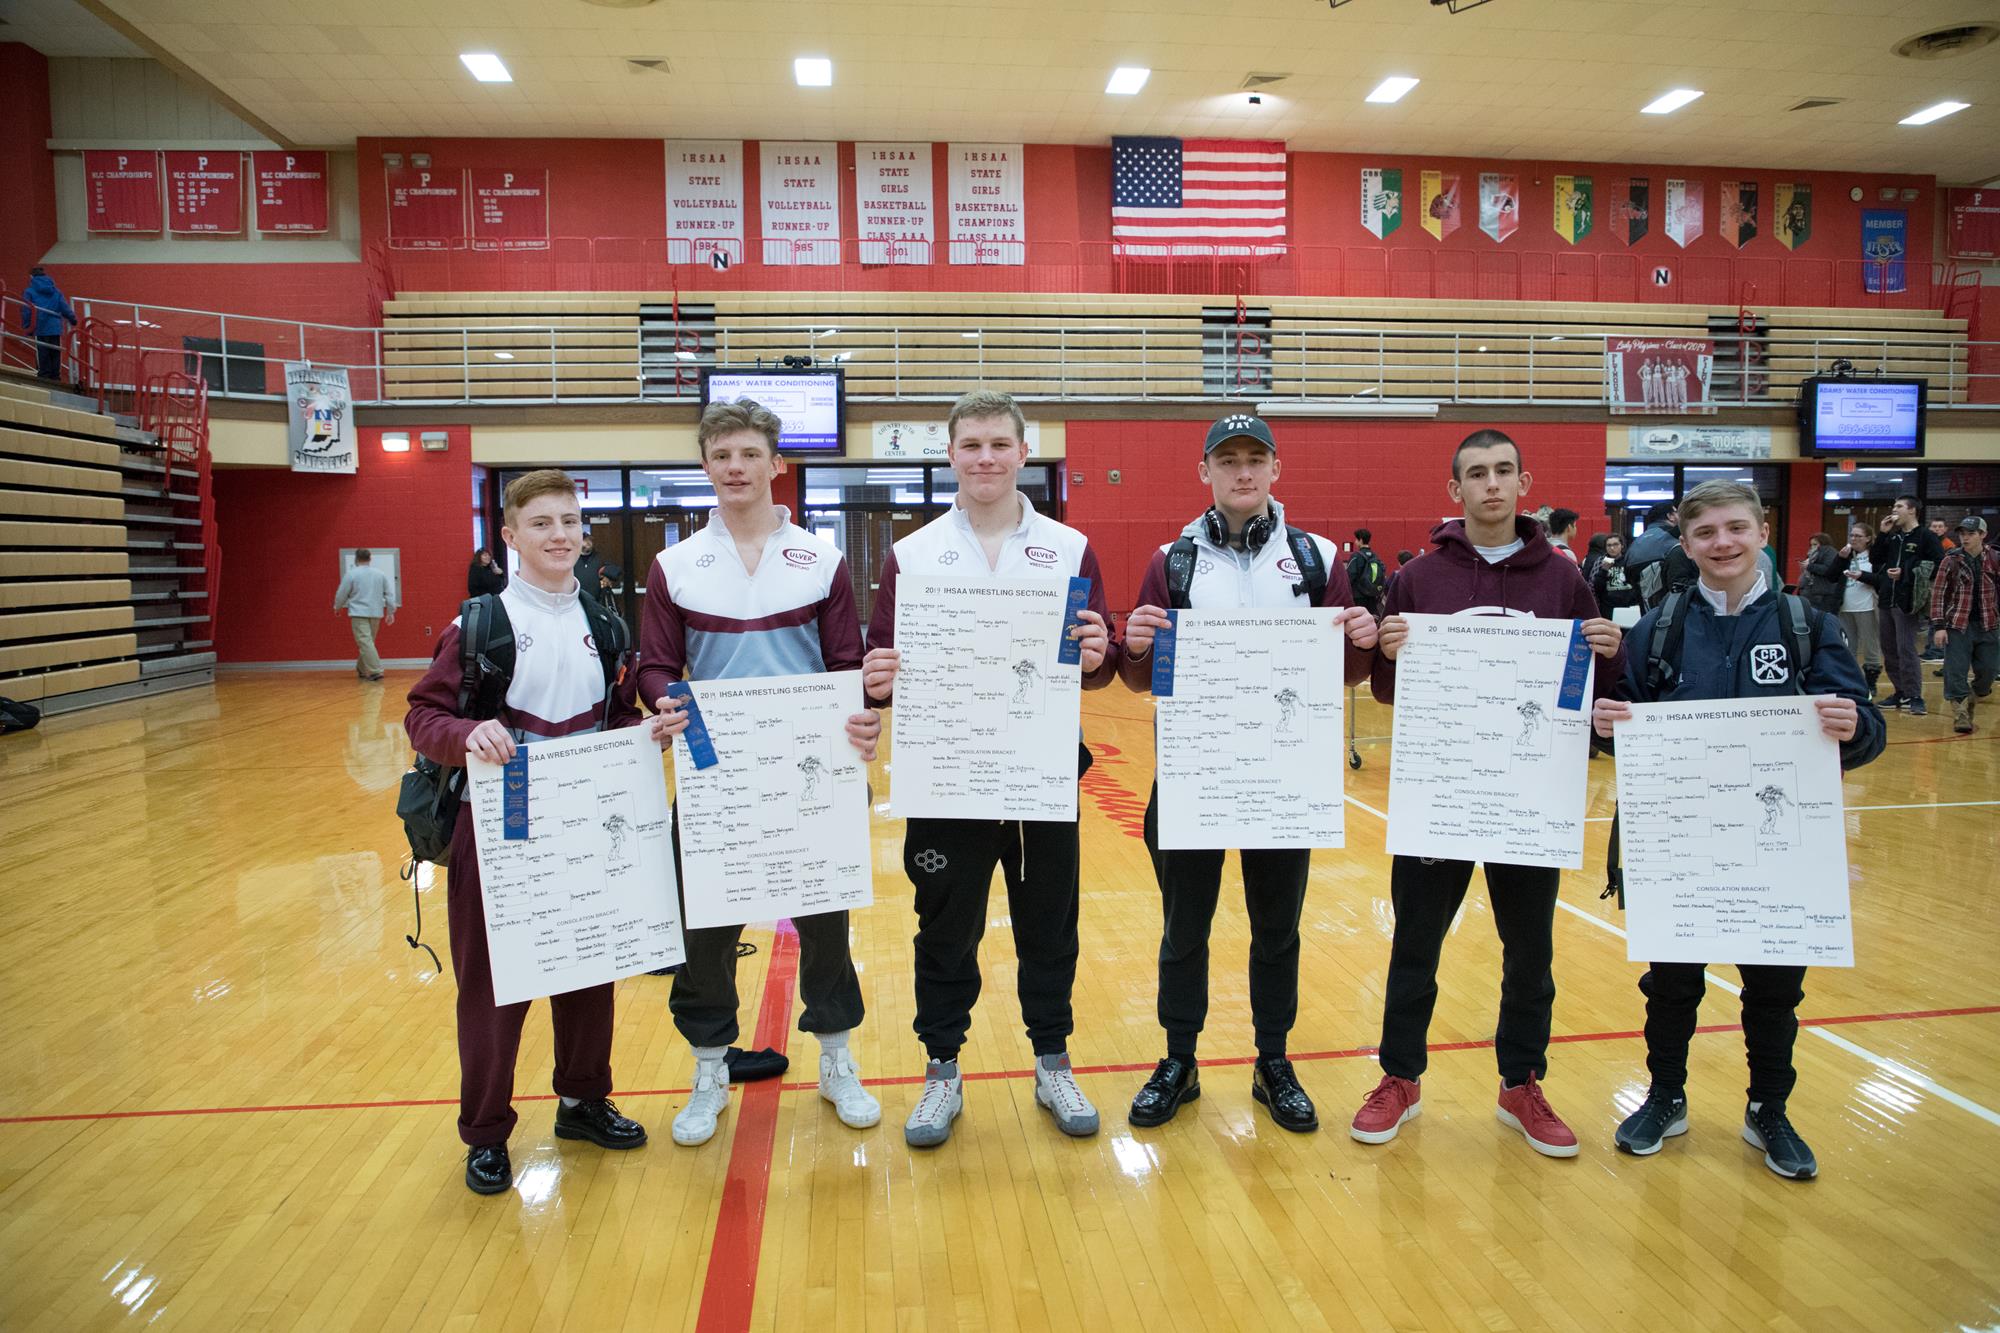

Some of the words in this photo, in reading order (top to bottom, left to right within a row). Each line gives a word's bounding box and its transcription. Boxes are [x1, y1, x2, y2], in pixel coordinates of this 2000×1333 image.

[682, 154, 726, 163] IHSAA
[777, 156, 821, 165] IHSAA
[872, 152, 916, 160] IHSAA
[964, 152, 1008, 162] IHSAA
[118, 156, 128, 170] P
[198, 156, 208, 170] P
[286, 156, 296, 170] P
[879, 168, 910, 177] STATE
[970, 169, 1002, 178] STATE
[420, 173, 431, 187] P
[504, 174, 514, 188] P
[688, 176, 720, 186] STATE
[784, 178, 816, 188] STATE
[880, 184, 909, 194] GIRLS
[972, 186, 1000, 195] GIRLS
[674, 200, 737, 208] VOLLEYBALL
[1974, 192, 1982, 206] P
[768, 200, 832, 210] VOLLEYBALL
[864, 200, 926, 210] BASKETBALL
[955, 203, 1018, 212] BASKETBALL
[676, 220, 735, 230] RUNNER-UP
[868, 216, 924, 226] RUNNER-UP
[958, 218, 1015, 227] CHAMPIONS
[1865, 220, 1904, 229] MEMBER
[772, 222, 830, 231] RUNNER-UP
[867, 232, 896, 240] CLASS
[957, 233, 986, 242] CLASS
[713, 252, 728, 269] N
[1655, 270, 1669, 284] N
[1228, 422, 1250, 430] DAY
[969, 588, 1014, 596] WRESTLING
[1016, 590, 1058, 598] SECTIONAL
[1274, 618, 1316, 626] SECTIONAL
[1448, 626, 1472, 634] IHSAA
[1473, 628, 1520, 636] WRESTLING
[1522, 630, 1566, 638] SECTIONAL
[720, 690, 744, 698] IHSAA
[745, 688, 791, 696] WRESTLING
[792, 684, 836, 694] SECTIONAL
[1666, 713, 1693, 721] IHSAA
[1694, 710, 1748, 720] WRESTLING
[1750, 708, 1802, 718] SECTIONAL
[528, 752, 546, 763] SAA
[547, 746, 592, 760] WRESTLING
[594, 738, 635, 752] SECTIONAL
[1454, 788, 1492, 796] CONSOLATION
[746, 850, 784, 859] CONSOLATION
[556, 914, 594, 926] CONSOLATION
[596, 908, 620, 919] BRACKET
